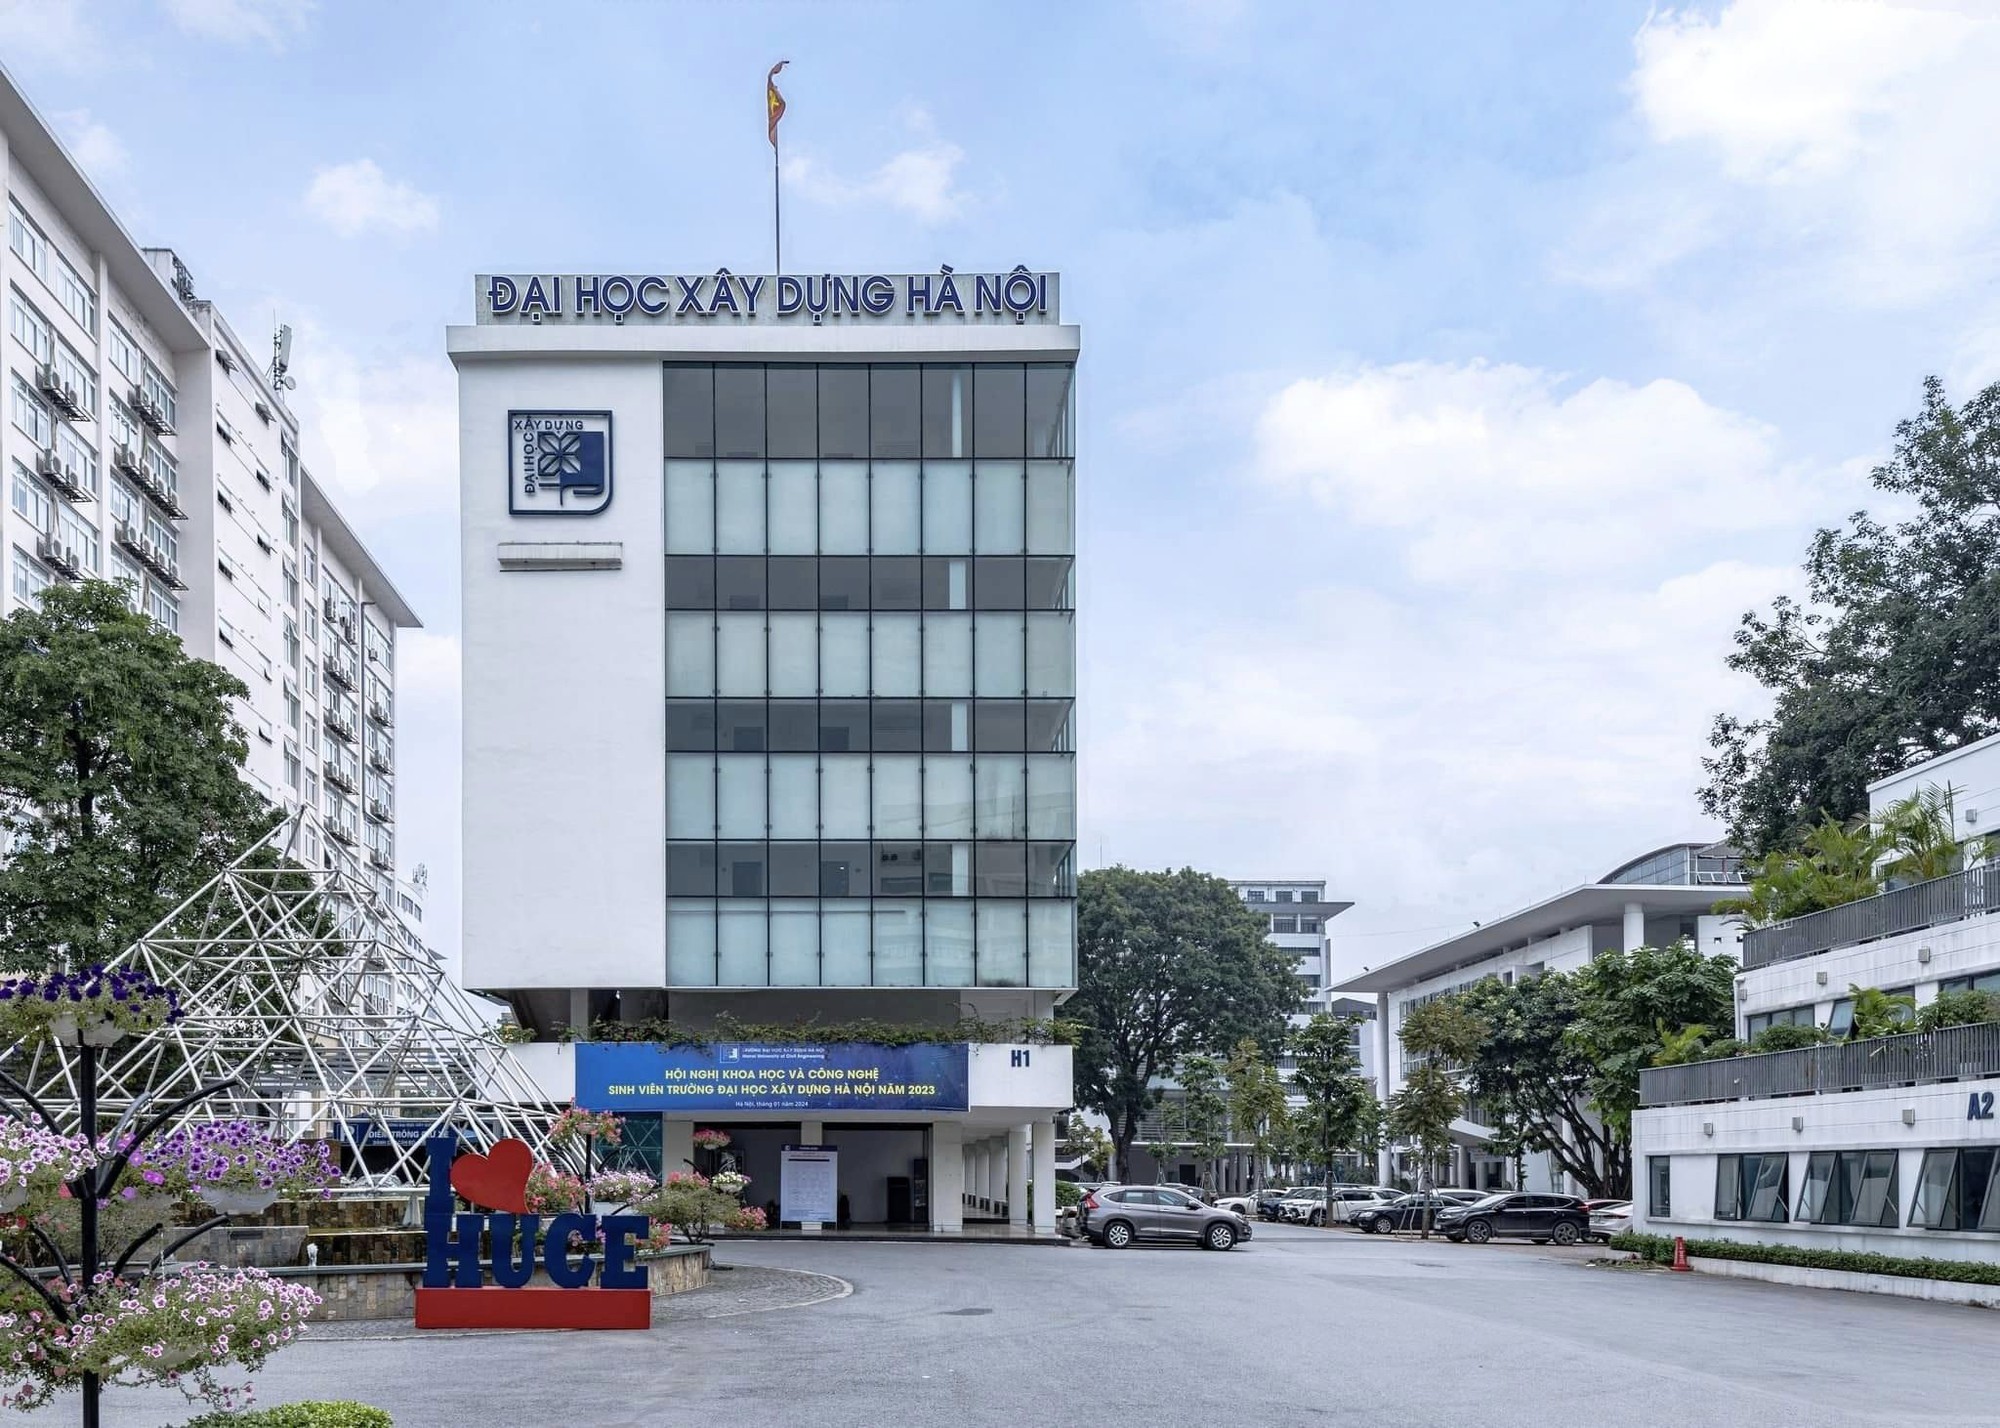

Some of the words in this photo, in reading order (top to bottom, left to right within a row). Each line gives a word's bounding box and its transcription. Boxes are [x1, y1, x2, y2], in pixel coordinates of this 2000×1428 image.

[487, 275, 562, 324] ĐẠI
[575, 274, 669, 324] HỌC
[675, 267, 765, 316] XÂY
[777, 273, 895, 325] DỰNG
[906, 263, 965, 314] HÀ
[974, 264, 1048, 323] NỘI
[514, 415, 541, 430] XÂY
[545, 420, 584, 433] DỰNG
[523, 432, 538, 465] HỌC
[523, 468, 539, 493] ĐẠI
[1011, 1050, 1030, 1067] H1
[665, 1067, 686, 1082] HỘI
[690, 1069, 719, 1082] NGHỊ
[722, 1069, 756, 1079] KHOA
[759, 1069, 785, 1082] HỌC
[788, 1067, 805, 1079] VÀ
[808, 1067, 844, 1079] CÔNG
[847, 1067, 879, 1082] NGHỆ
[608, 1084, 635, 1095] SINH
[638, 1082, 664, 1095] VIÊN
[667, 1082, 714, 1095] TRƯỜNG
[717, 1084, 738, 1097] ĐẠI
[741, 1084, 768, 1097] HỌC
[771, 1082, 794, 1095] XÂY
[797, 1084, 831, 1097] DỰNG
[834, 1082, 851, 1095] HÀ
[854, 1082, 875, 1097] NỘI
[878, 1083, 905, 1095] NĂM
[908, 1085, 935, 1095] 2023
[1967, 1092, 1994, 1120] A2
[423, 1213, 650, 1288] HUCE
